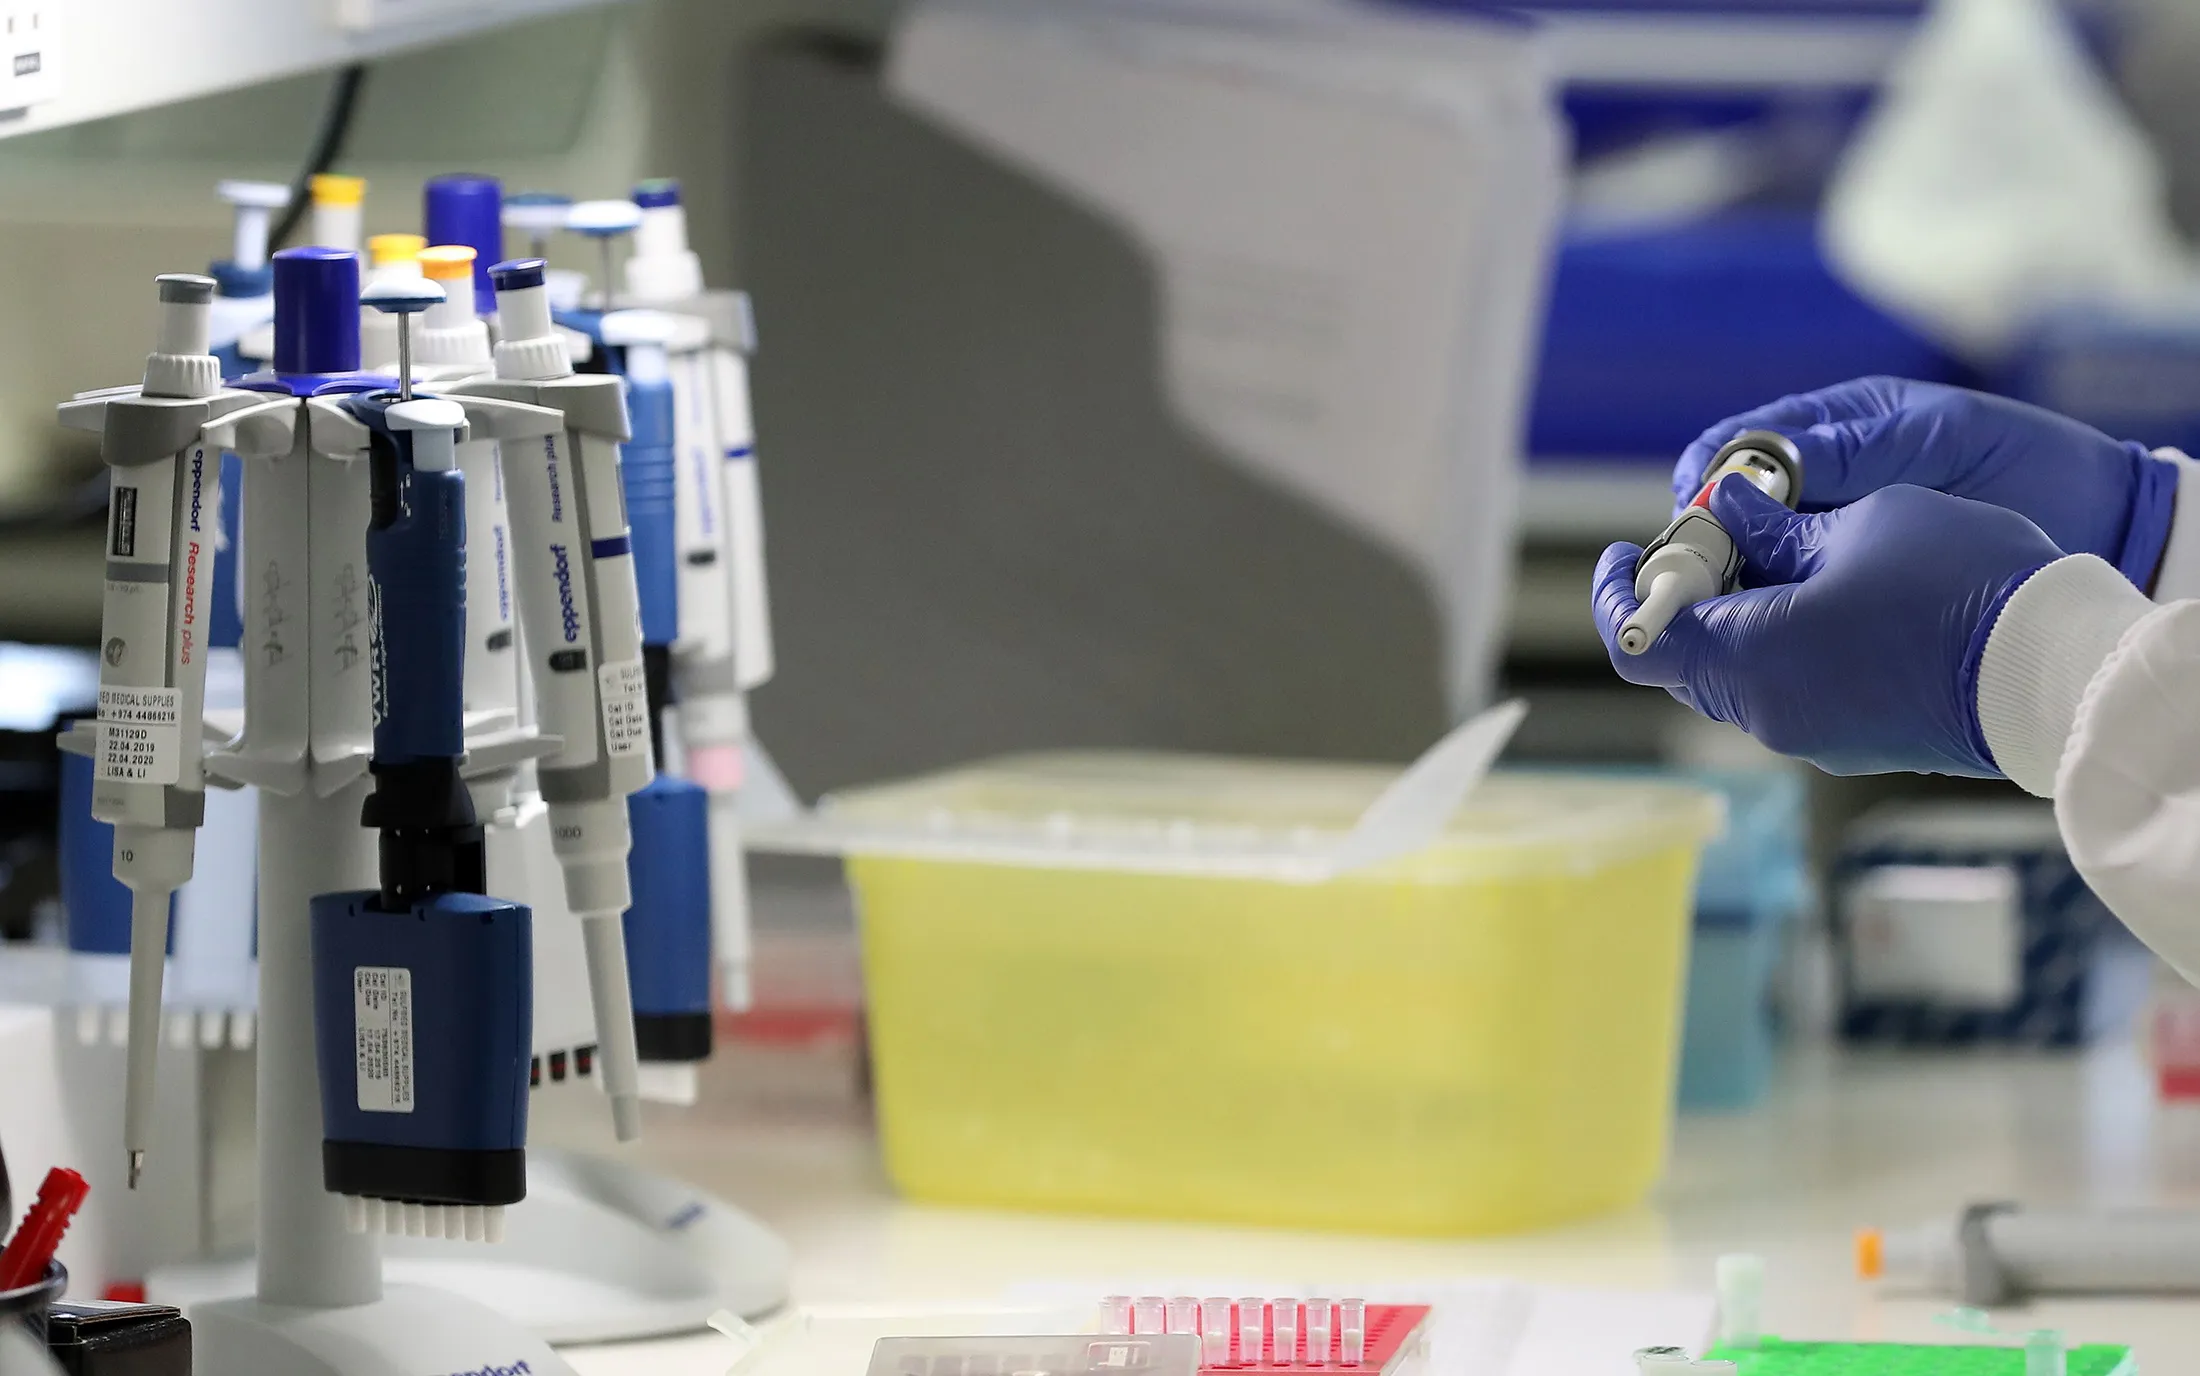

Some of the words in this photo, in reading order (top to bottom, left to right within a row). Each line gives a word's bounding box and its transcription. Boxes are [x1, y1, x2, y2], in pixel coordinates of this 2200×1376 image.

[190, 449, 203, 532] eppendorf
[547, 463, 563, 523] Research
[1684, 547, 1709, 563] 200
[185, 541, 199, 625] Research
[550, 543, 581, 643] eppendorf
[181, 628, 192, 665] plus
[111, 692, 140, 706] MEDICAL
[142, 694, 174, 708] SUPPLIES
[111, 709, 132, 719] +974
[108, 740, 155, 752] 22.04.2019
[107, 753, 154, 765] 22.04.2020
[107, 766, 124, 777] LISA
[126, 767, 133, 778] &
[137, 768, 146, 779] LI
[120, 849, 134, 862] 10
